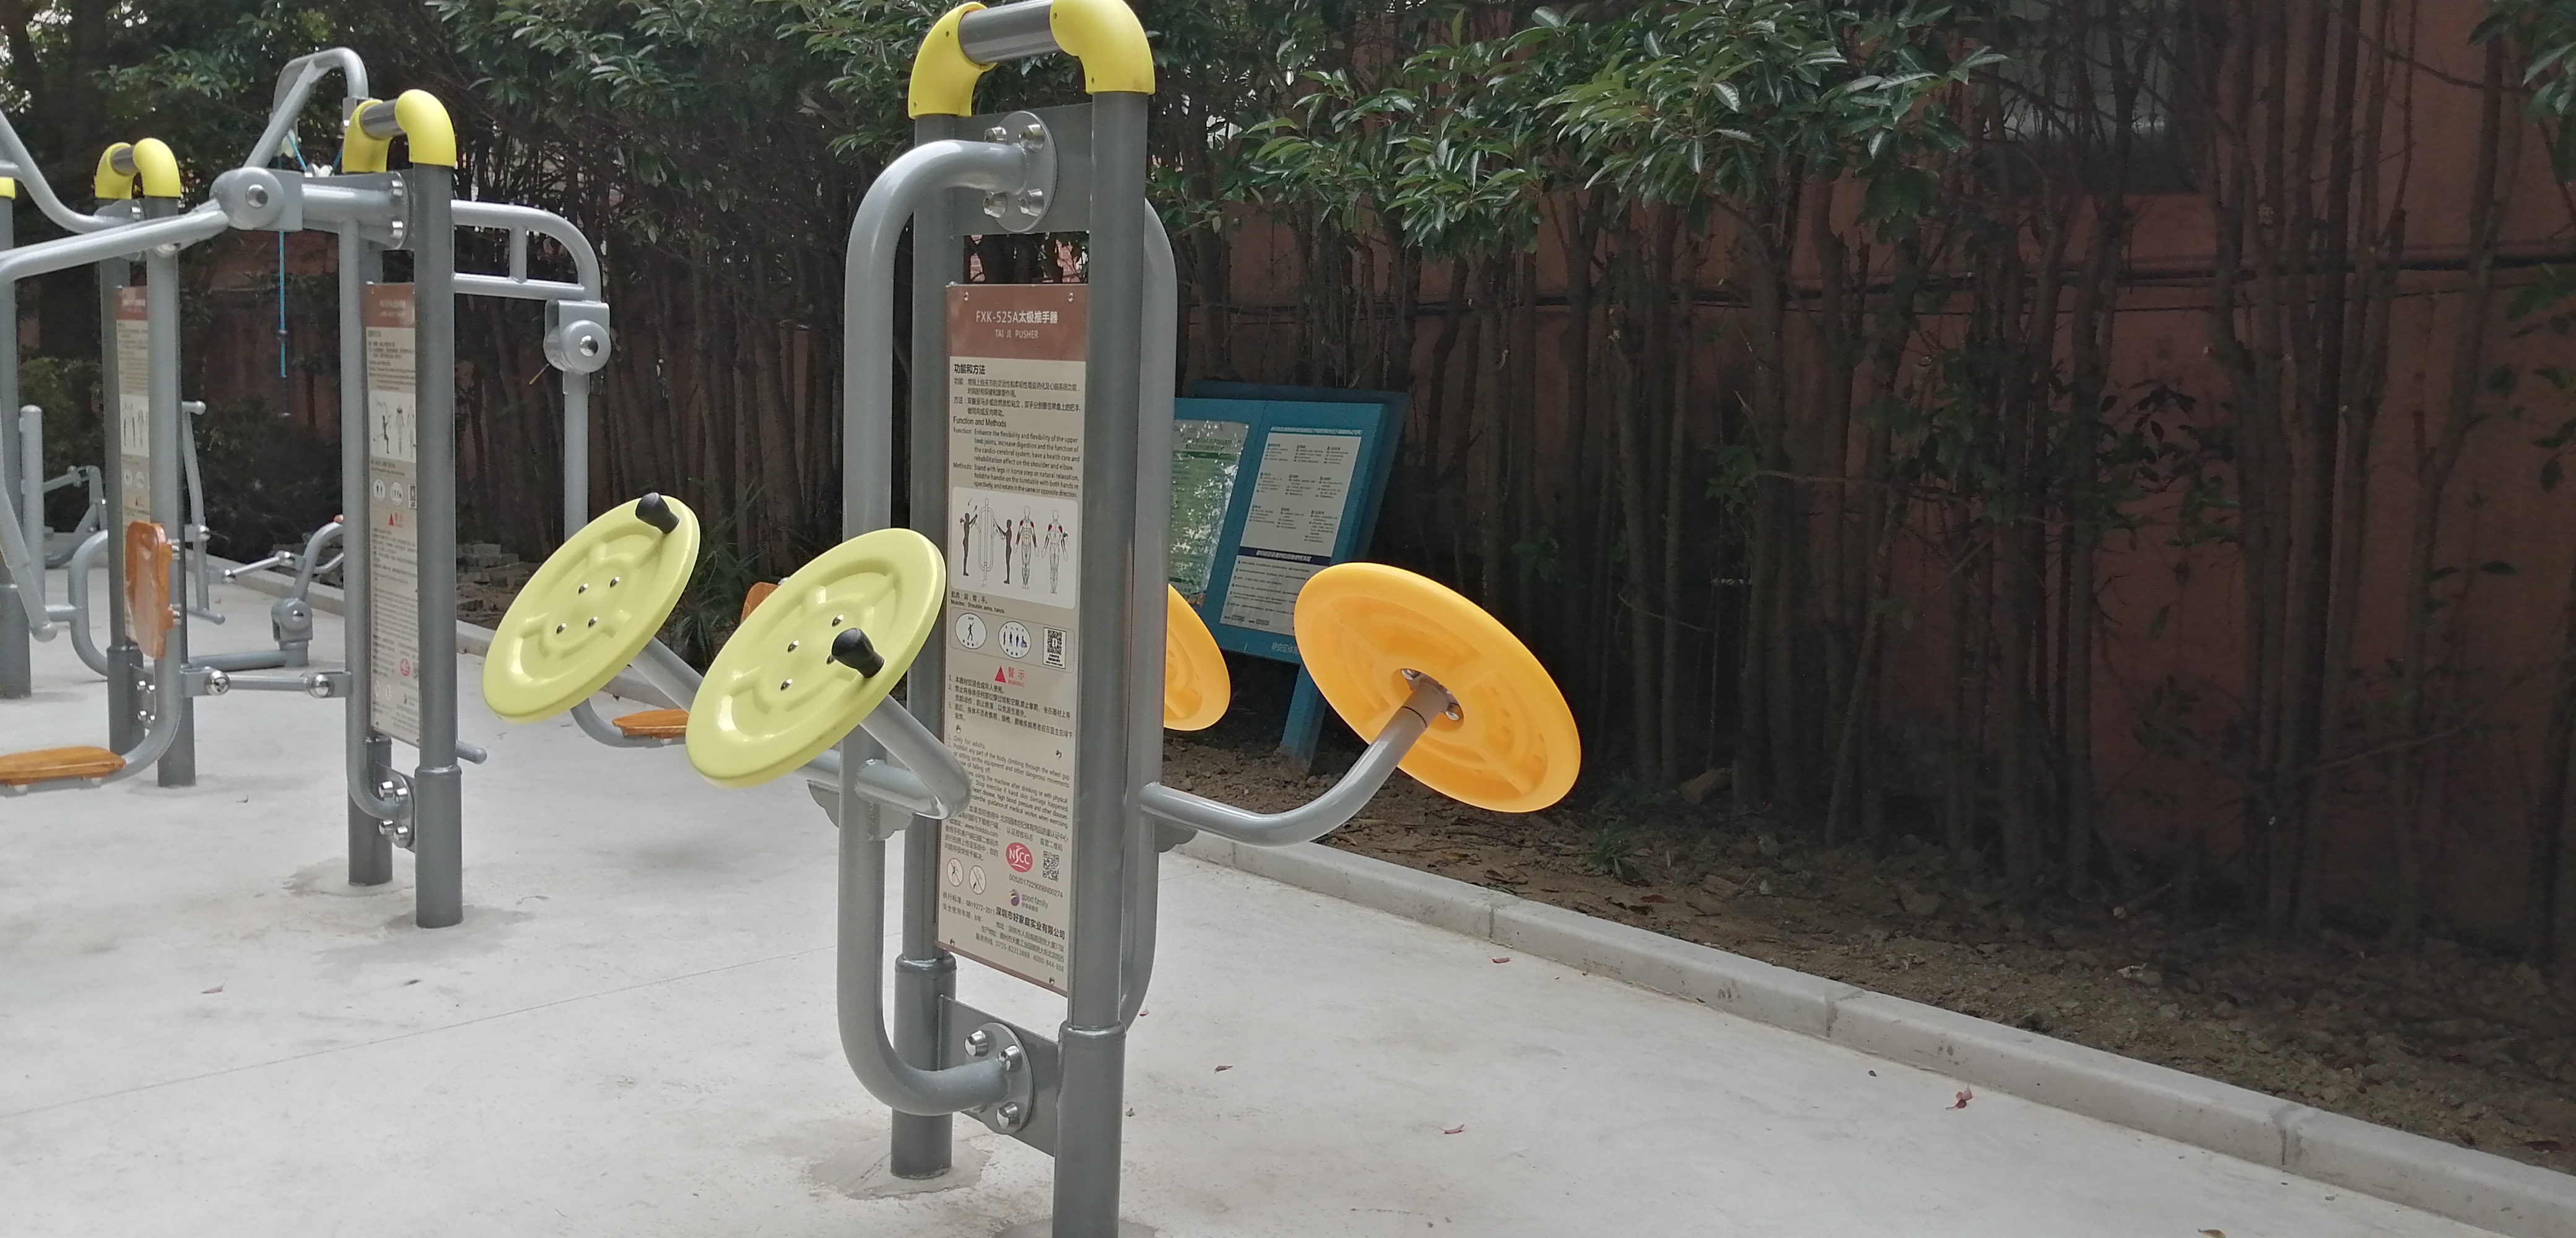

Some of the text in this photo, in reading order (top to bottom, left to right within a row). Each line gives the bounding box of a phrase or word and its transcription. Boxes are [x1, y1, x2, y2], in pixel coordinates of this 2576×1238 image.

[976, 311, 1058, 324] FXK-525A太极推手器
[995, 329, 1004, 337] TAI
[1015, 330, 1038, 339] PUSHER
[954, 363, 985, 374] 功能和方法
[953, 416, 973, 425] Function
[986, 418, 1006, 428] Methods
[1001, 430, 1020, 440] flexibility
[1030, 433, 1050, 443] flexibility
[982, 448, 1014, 456] cardio-cerebral
[1016, 441, 1037, 449] digestion
[1055, 444, 1073, 452] function
[974, 456, 1002, 464] rehabilitation
[991, 474, 1004, 482] handle
[1060, 481, 1073, 489] hands
[954, 735, 964, 744] Only
[996, 755, 1006, 764] body
[1025, 762, 1040, 773] through
[1050, 769, 1061, 777] wheel
[1062, 773, 1070, 781] gap
[1009, 846, 1030, 865] NSCC
[1021, 894, 1049, 909] good family
[996, 906, 1065, 940] 深圳市好家庭实业有限公司
